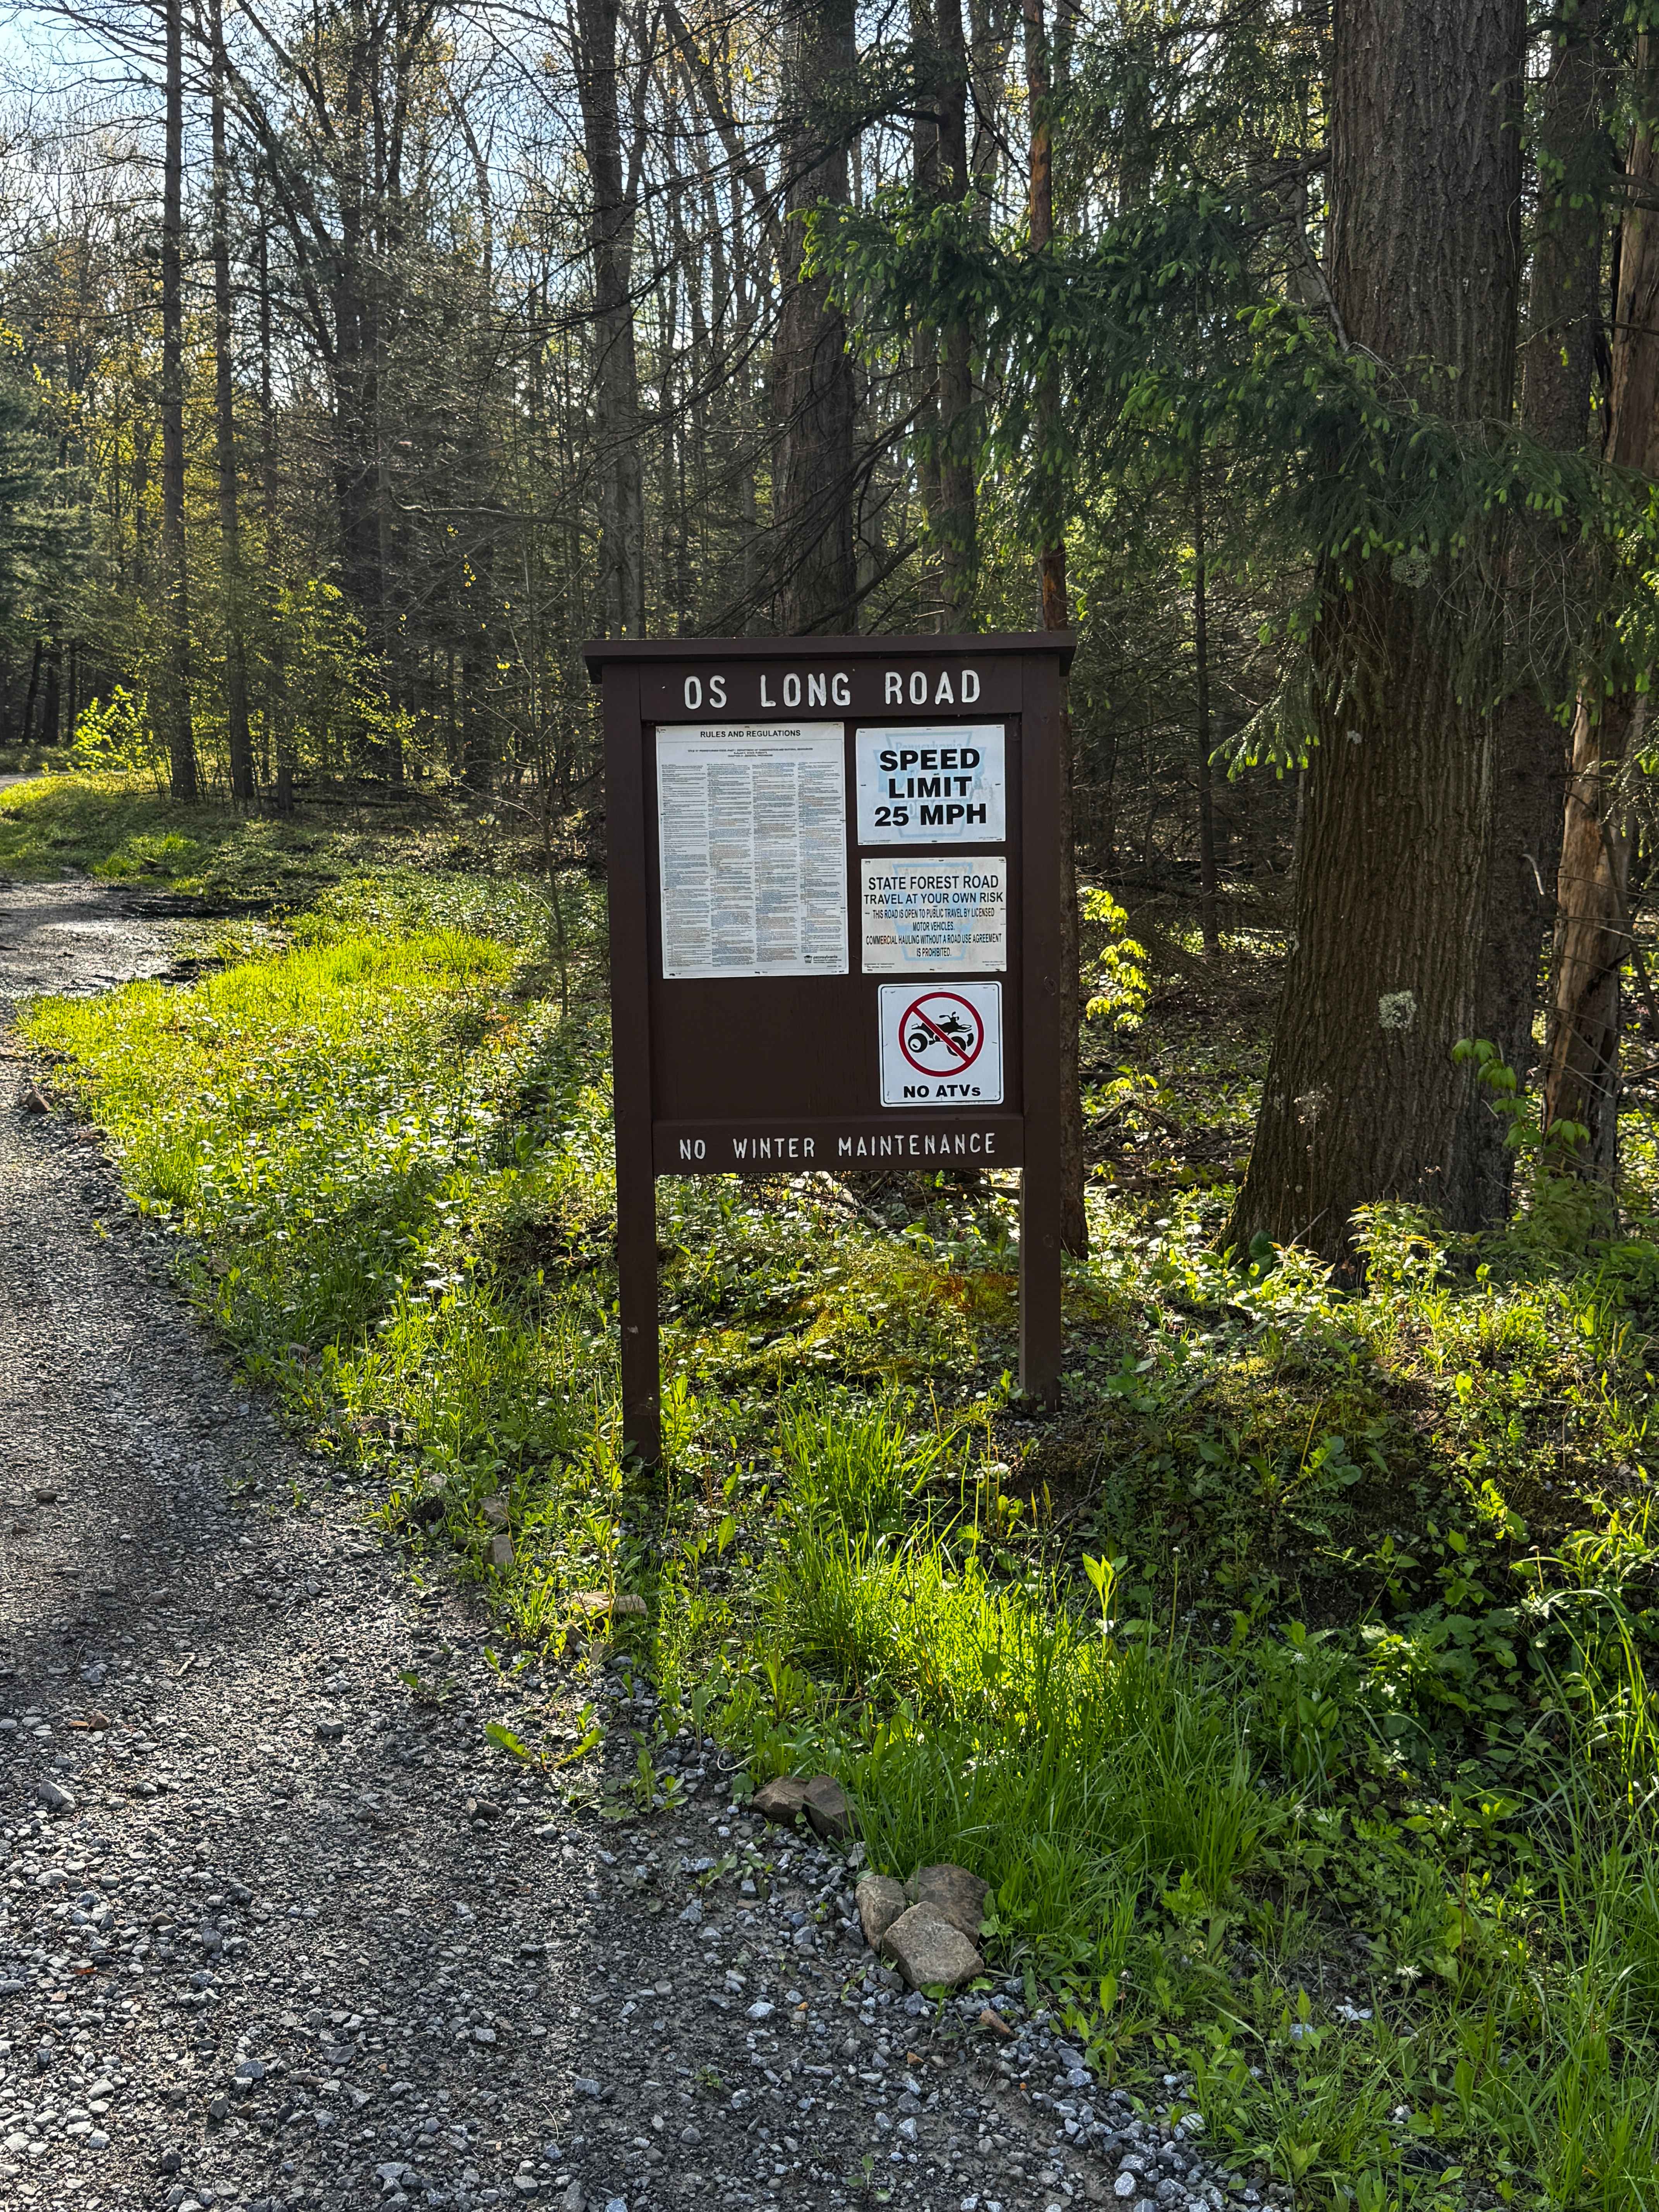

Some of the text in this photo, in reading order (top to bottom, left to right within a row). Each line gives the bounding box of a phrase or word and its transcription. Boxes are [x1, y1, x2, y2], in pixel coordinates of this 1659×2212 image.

[684, 670, 980, 709] OS LONG ROAD
[879, 748, 980, 772] SPEED
[889, 776, 972, 799] LIMIT
[874, 806, 909, 827] 25
[920, 803, 986, 826] MPH
[869, 875, 998, 890] STATE FOREST ROAD
[864, 892, 1003, 905] TRAVEL AT YOUR OWN RISK
[872, 908, 994, 919] THIS ROAD IS OPEN TO PUBLIC TRAVEL BY LICENSED
[913, 921, 955, 931] MOTOR VEHICLES.
[866, 933, 1002, 945] COMMERCIAL HAULING WITHOUT A ROAD USE AGREEMENT
[917, 947, 951, 957] IS PROHIBITED.
[903, 1084, 981, 1098] NO ATVs
[679, 1132, 995, 1160] NO WINTER MAINTENANCE
